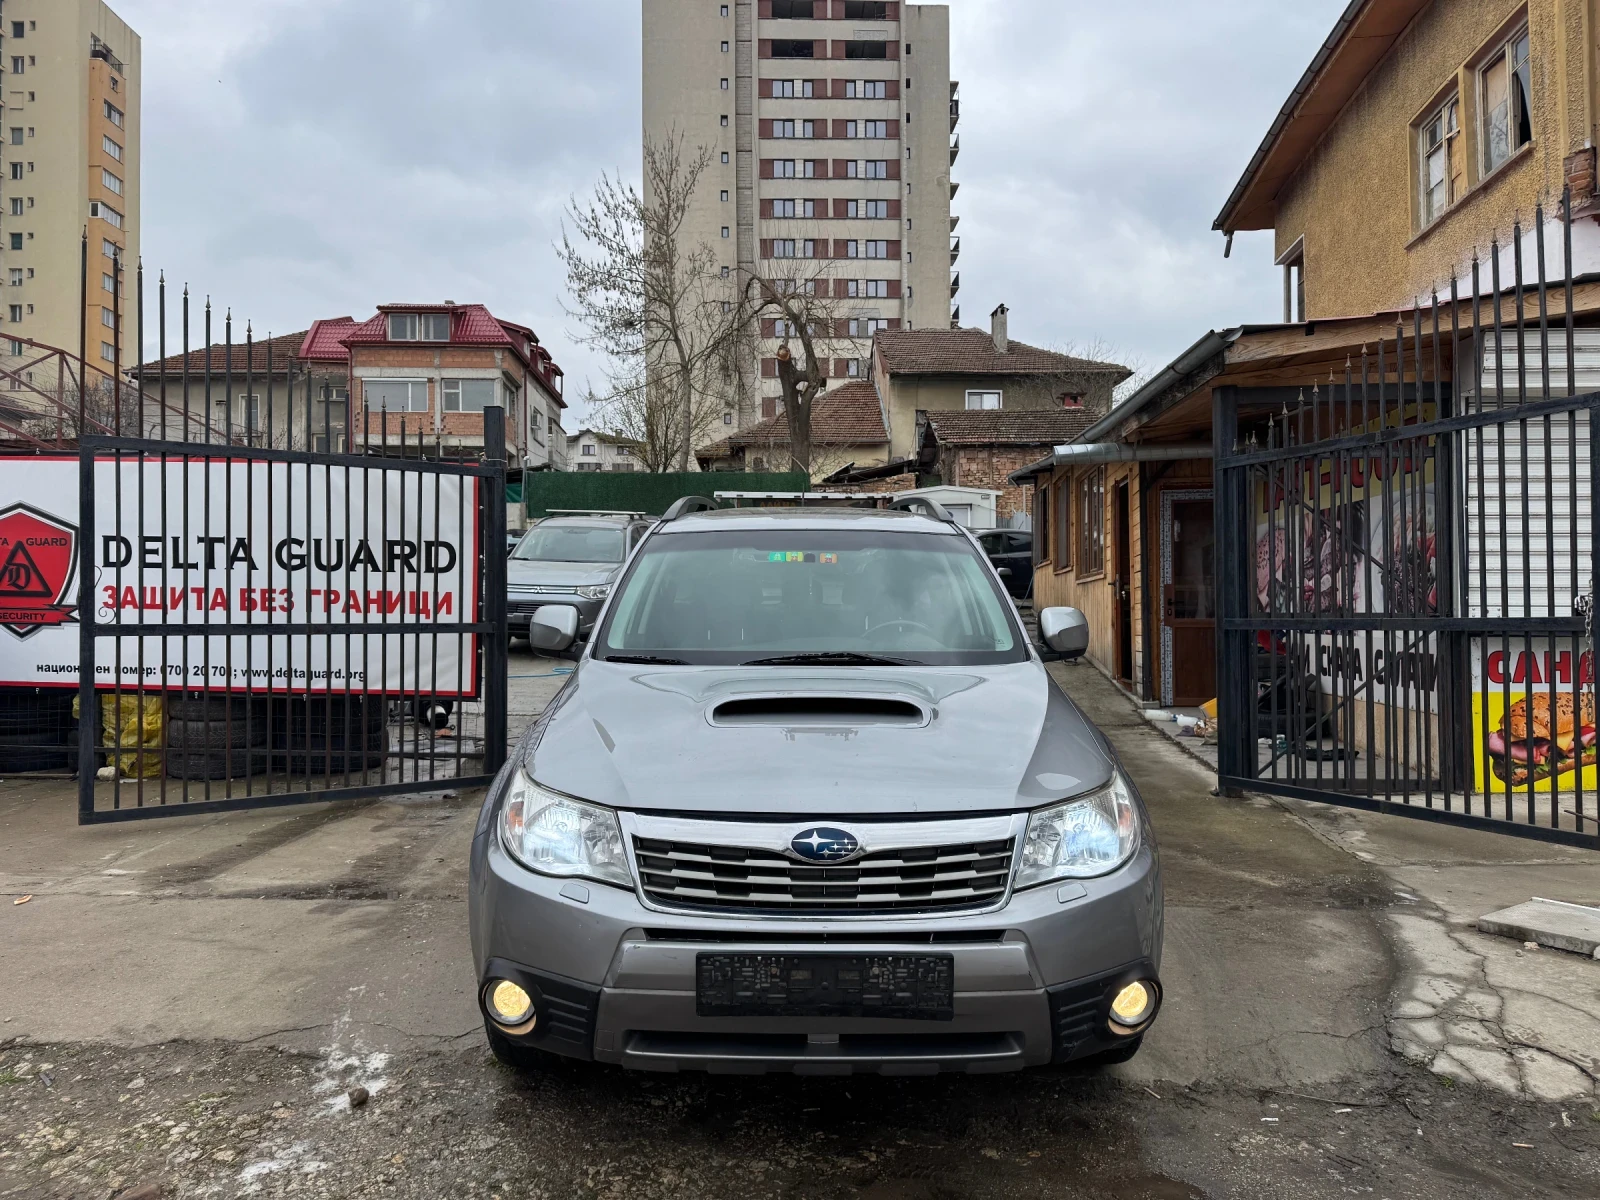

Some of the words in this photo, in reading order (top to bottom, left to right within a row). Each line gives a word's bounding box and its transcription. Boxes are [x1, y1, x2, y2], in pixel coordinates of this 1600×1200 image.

[26, 537, 68, 546] GUARD
[102, 535, 259, 571] DELTA
[275, 537, 457, 574] GUARD
[102, 585, 228, 615] ЗАЩИТА
[239, 588, 295, 612] БЕЗ
[306, 589, 452, 620] ГРАНИЦИ
[36, 664, 110, 674] национен
